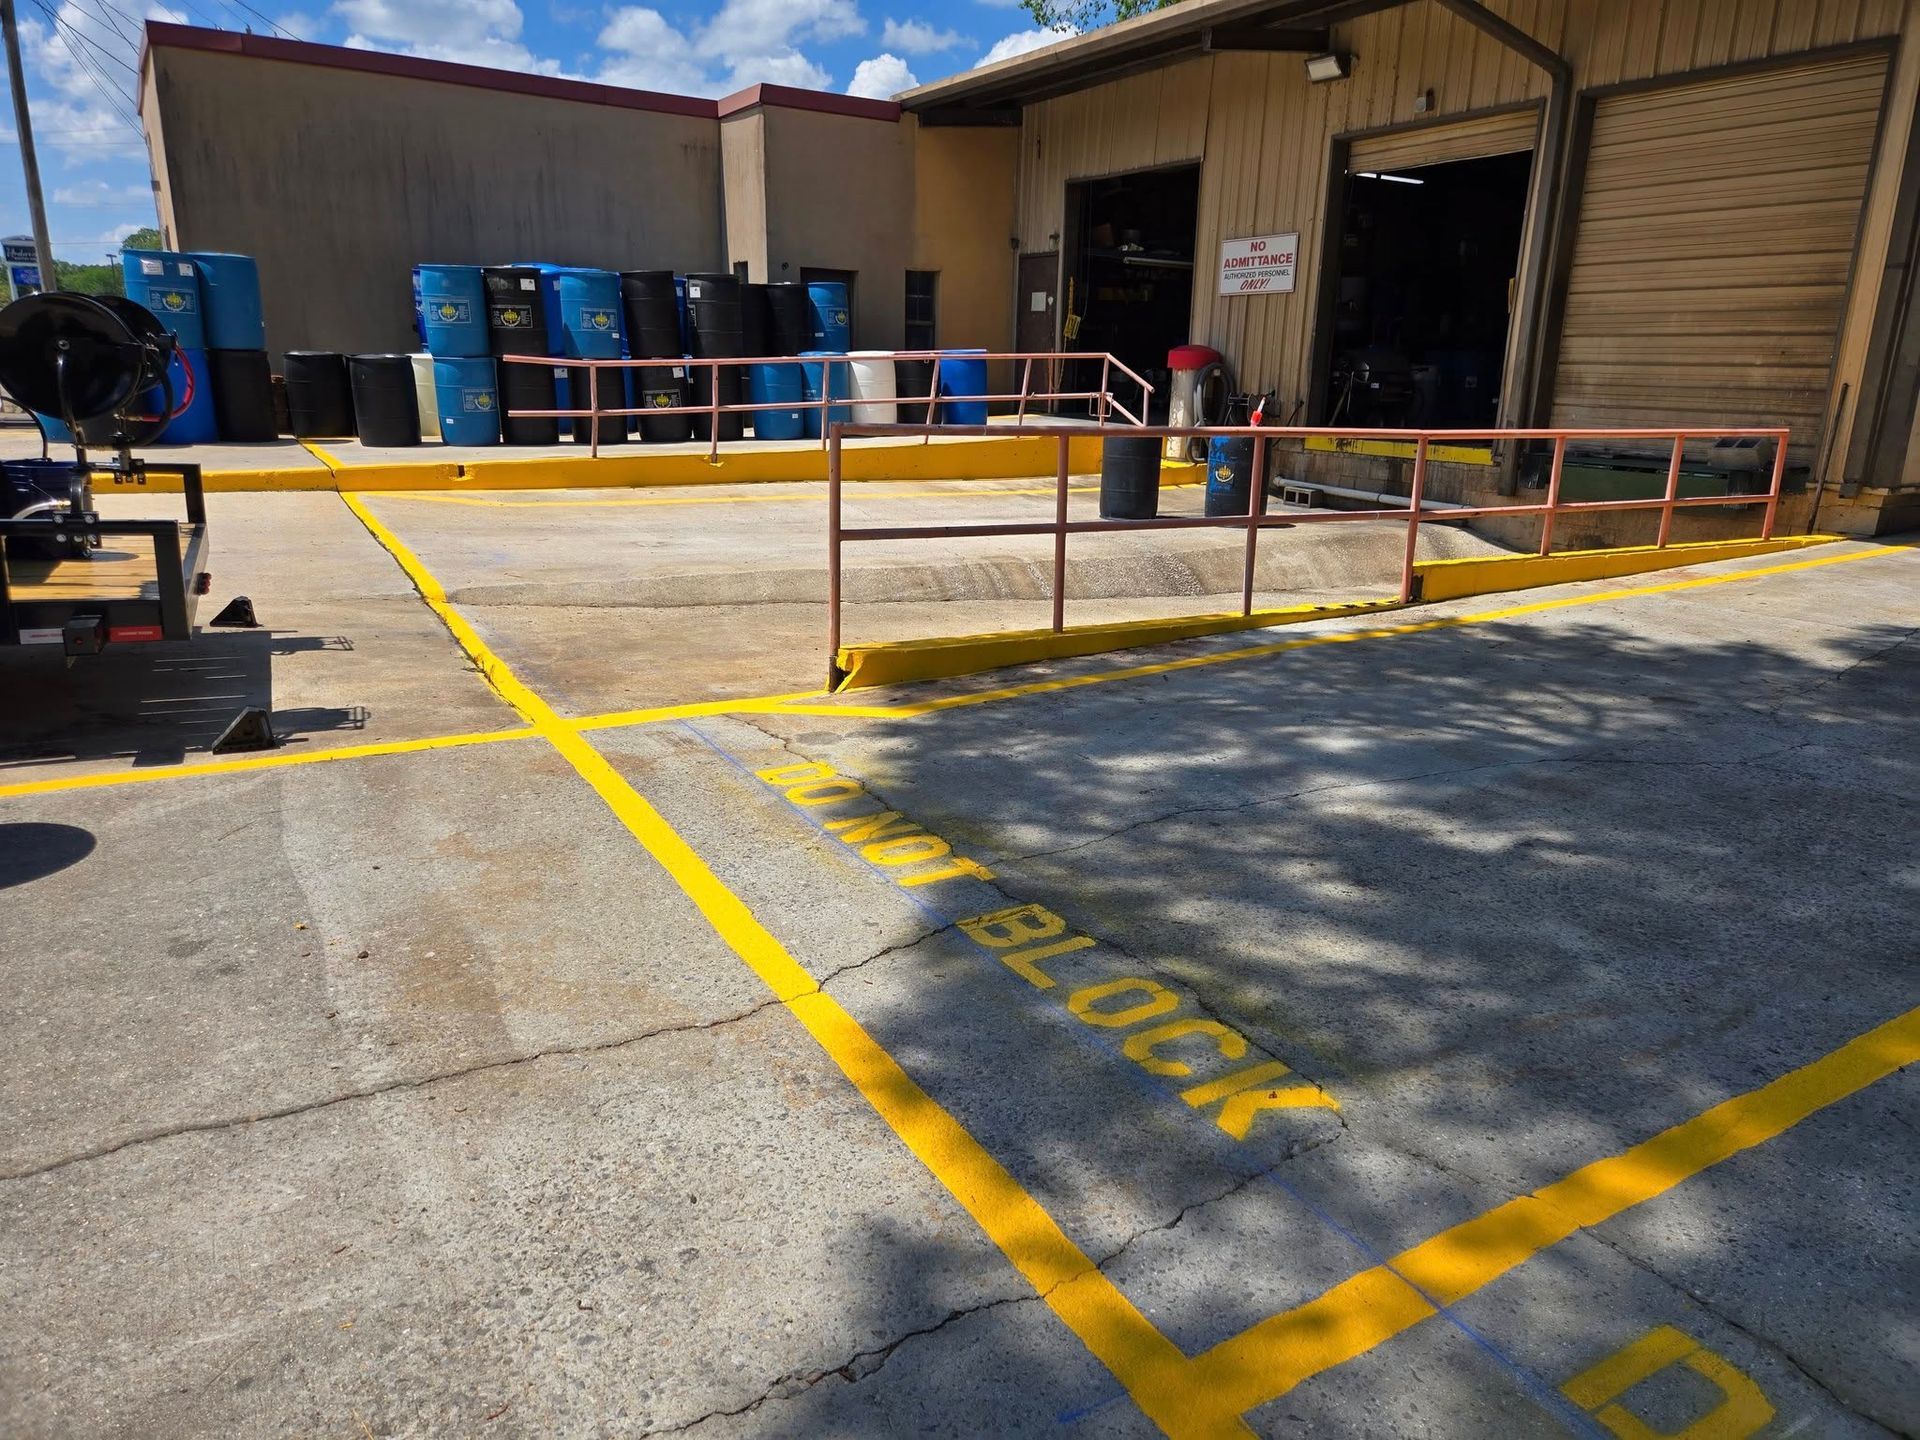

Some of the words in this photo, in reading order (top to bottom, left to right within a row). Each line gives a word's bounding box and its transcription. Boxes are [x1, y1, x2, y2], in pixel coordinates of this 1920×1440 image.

[1250, 241, 1266, 252] NO
[1224, 253, 1293, 269] ADMITTANCE
[1224, 271, 1256, 280] AUTHORIZED
[1258, 269, 1290, 278] PERSONNEL
[1240, 278, 1271, 290] ONLY!
[755, 761, 865, 807] DO
[823, 810, 997, 887] NOT
[956, 903, 1342, 1142] BLOCK
